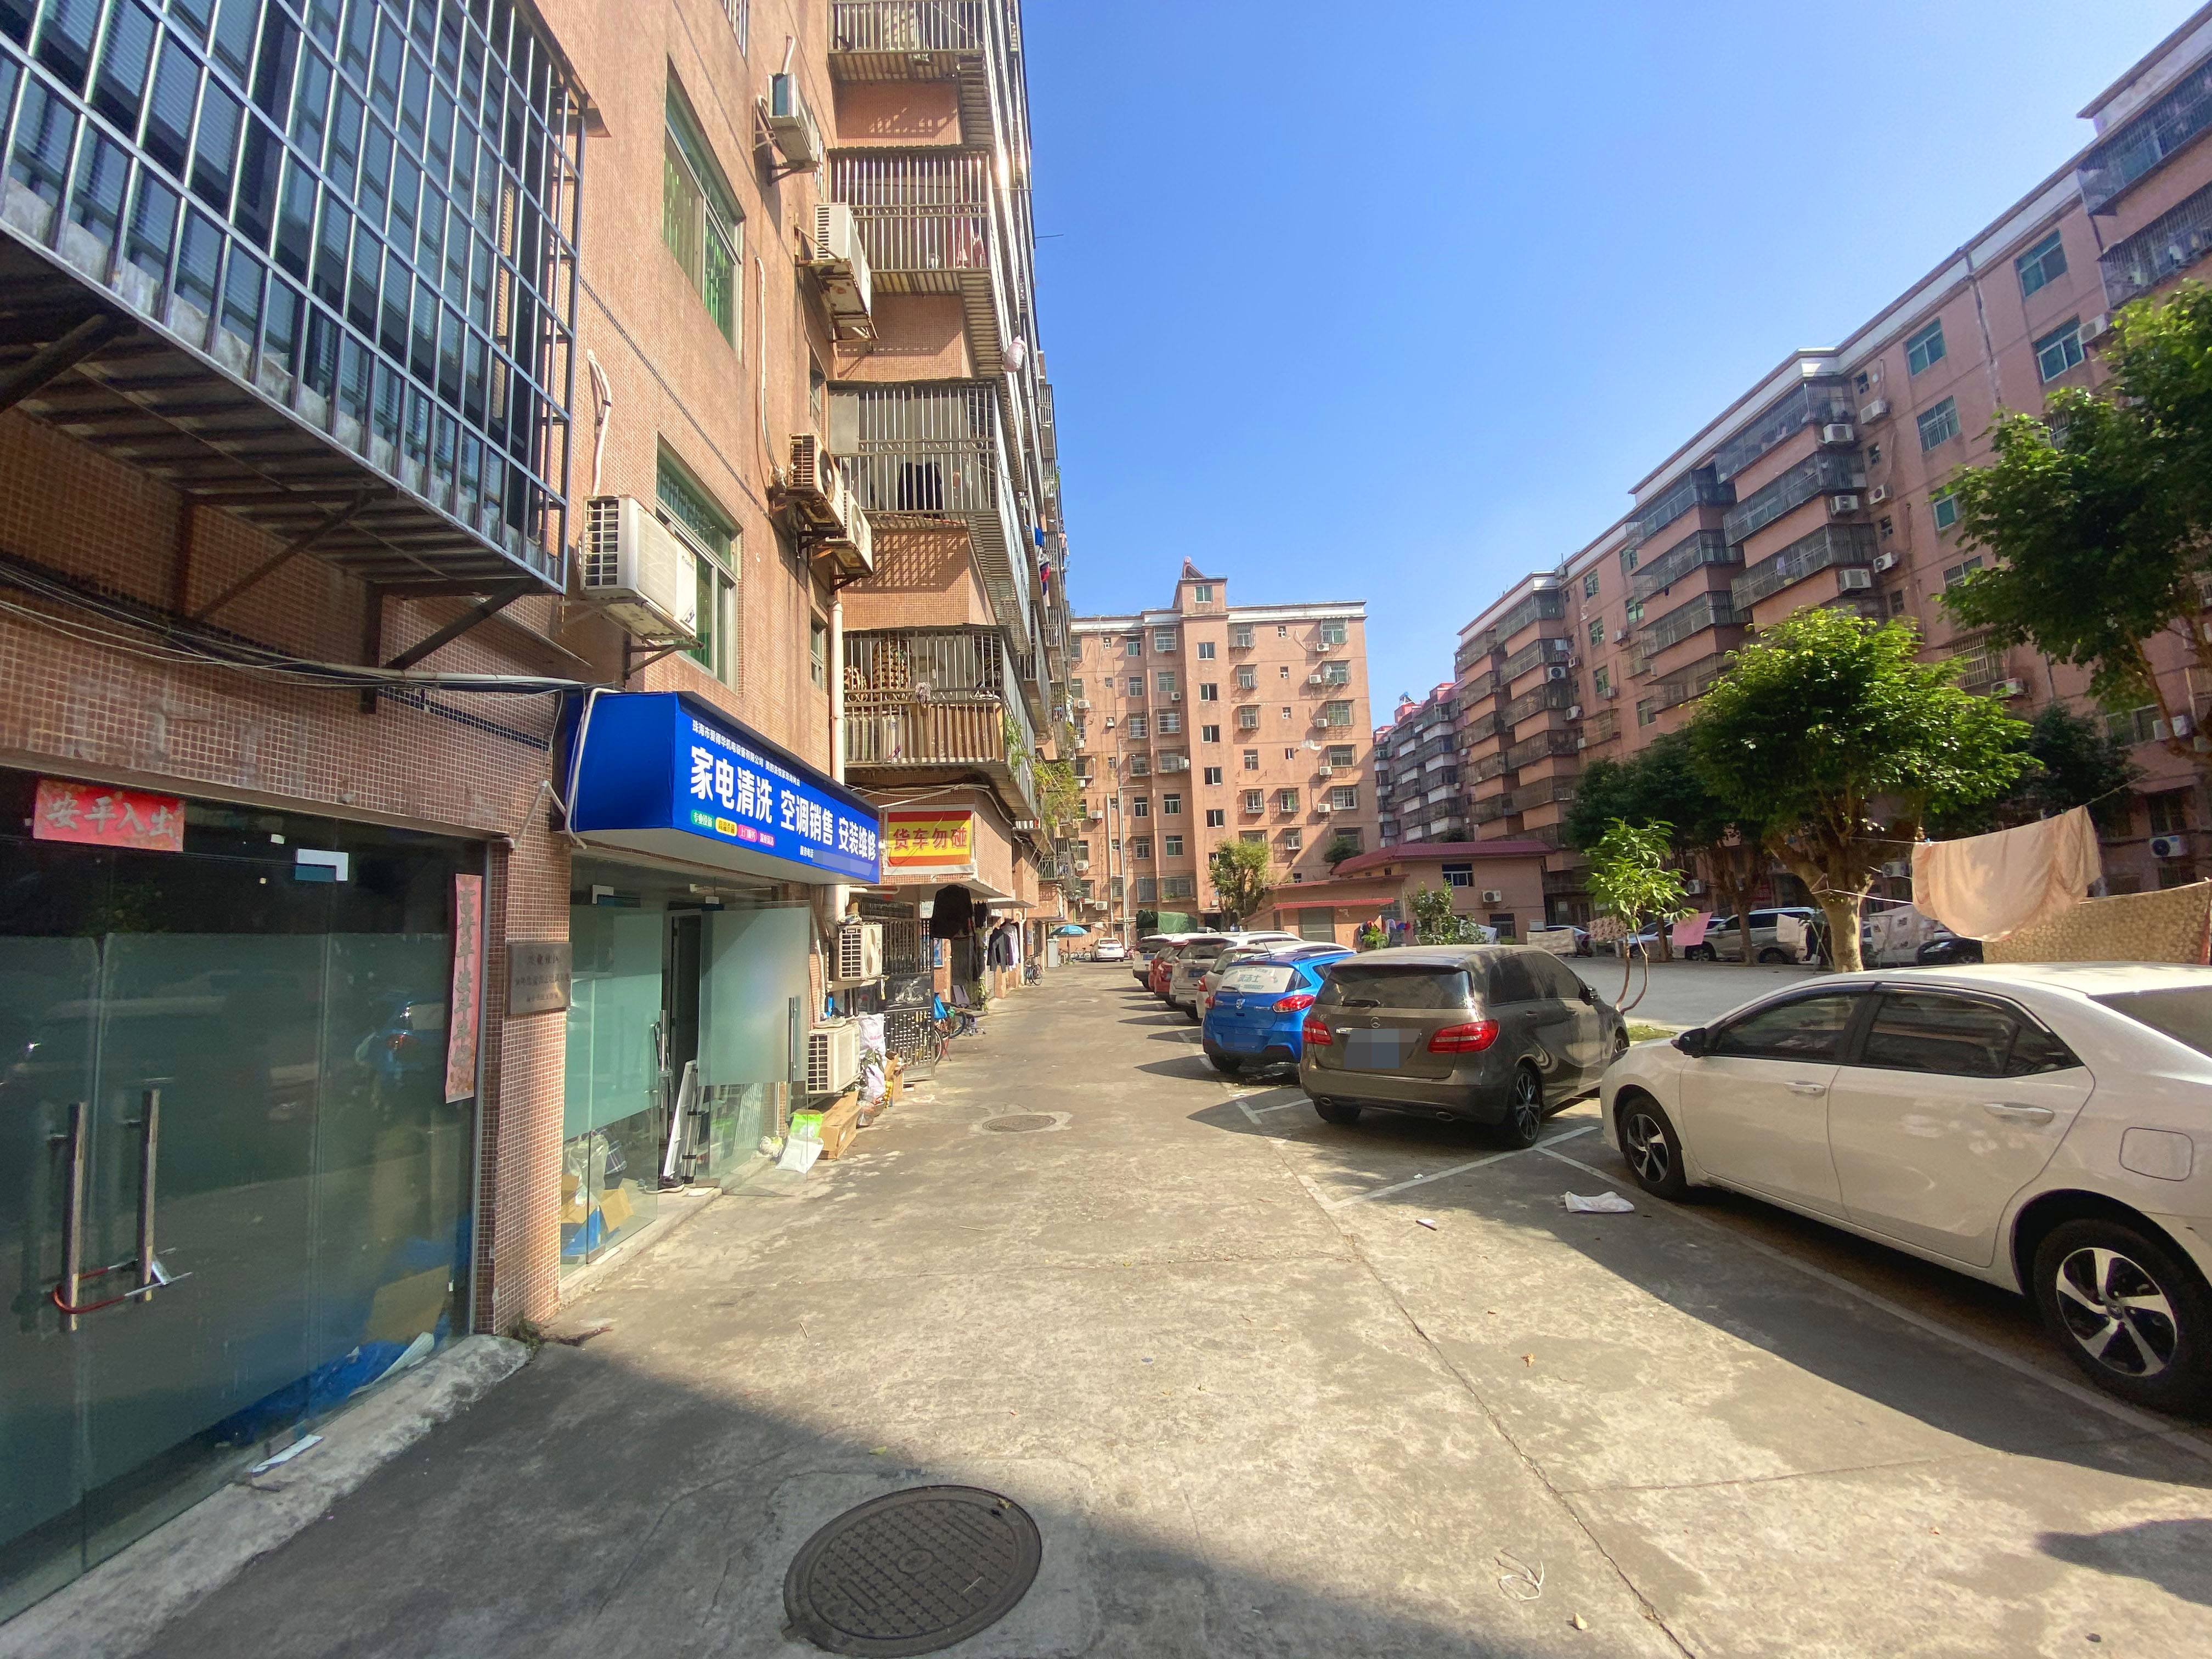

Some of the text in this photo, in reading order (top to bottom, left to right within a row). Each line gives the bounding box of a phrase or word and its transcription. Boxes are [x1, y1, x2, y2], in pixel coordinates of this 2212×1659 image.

[690, 746, 876, 861] 家电清洗 空调销售 安装维修
[693, 811, 713, 828] 专业设备
[741, 826, 756, 841] 上门服务
[893, 827, 968, 851] 货车勿碰
